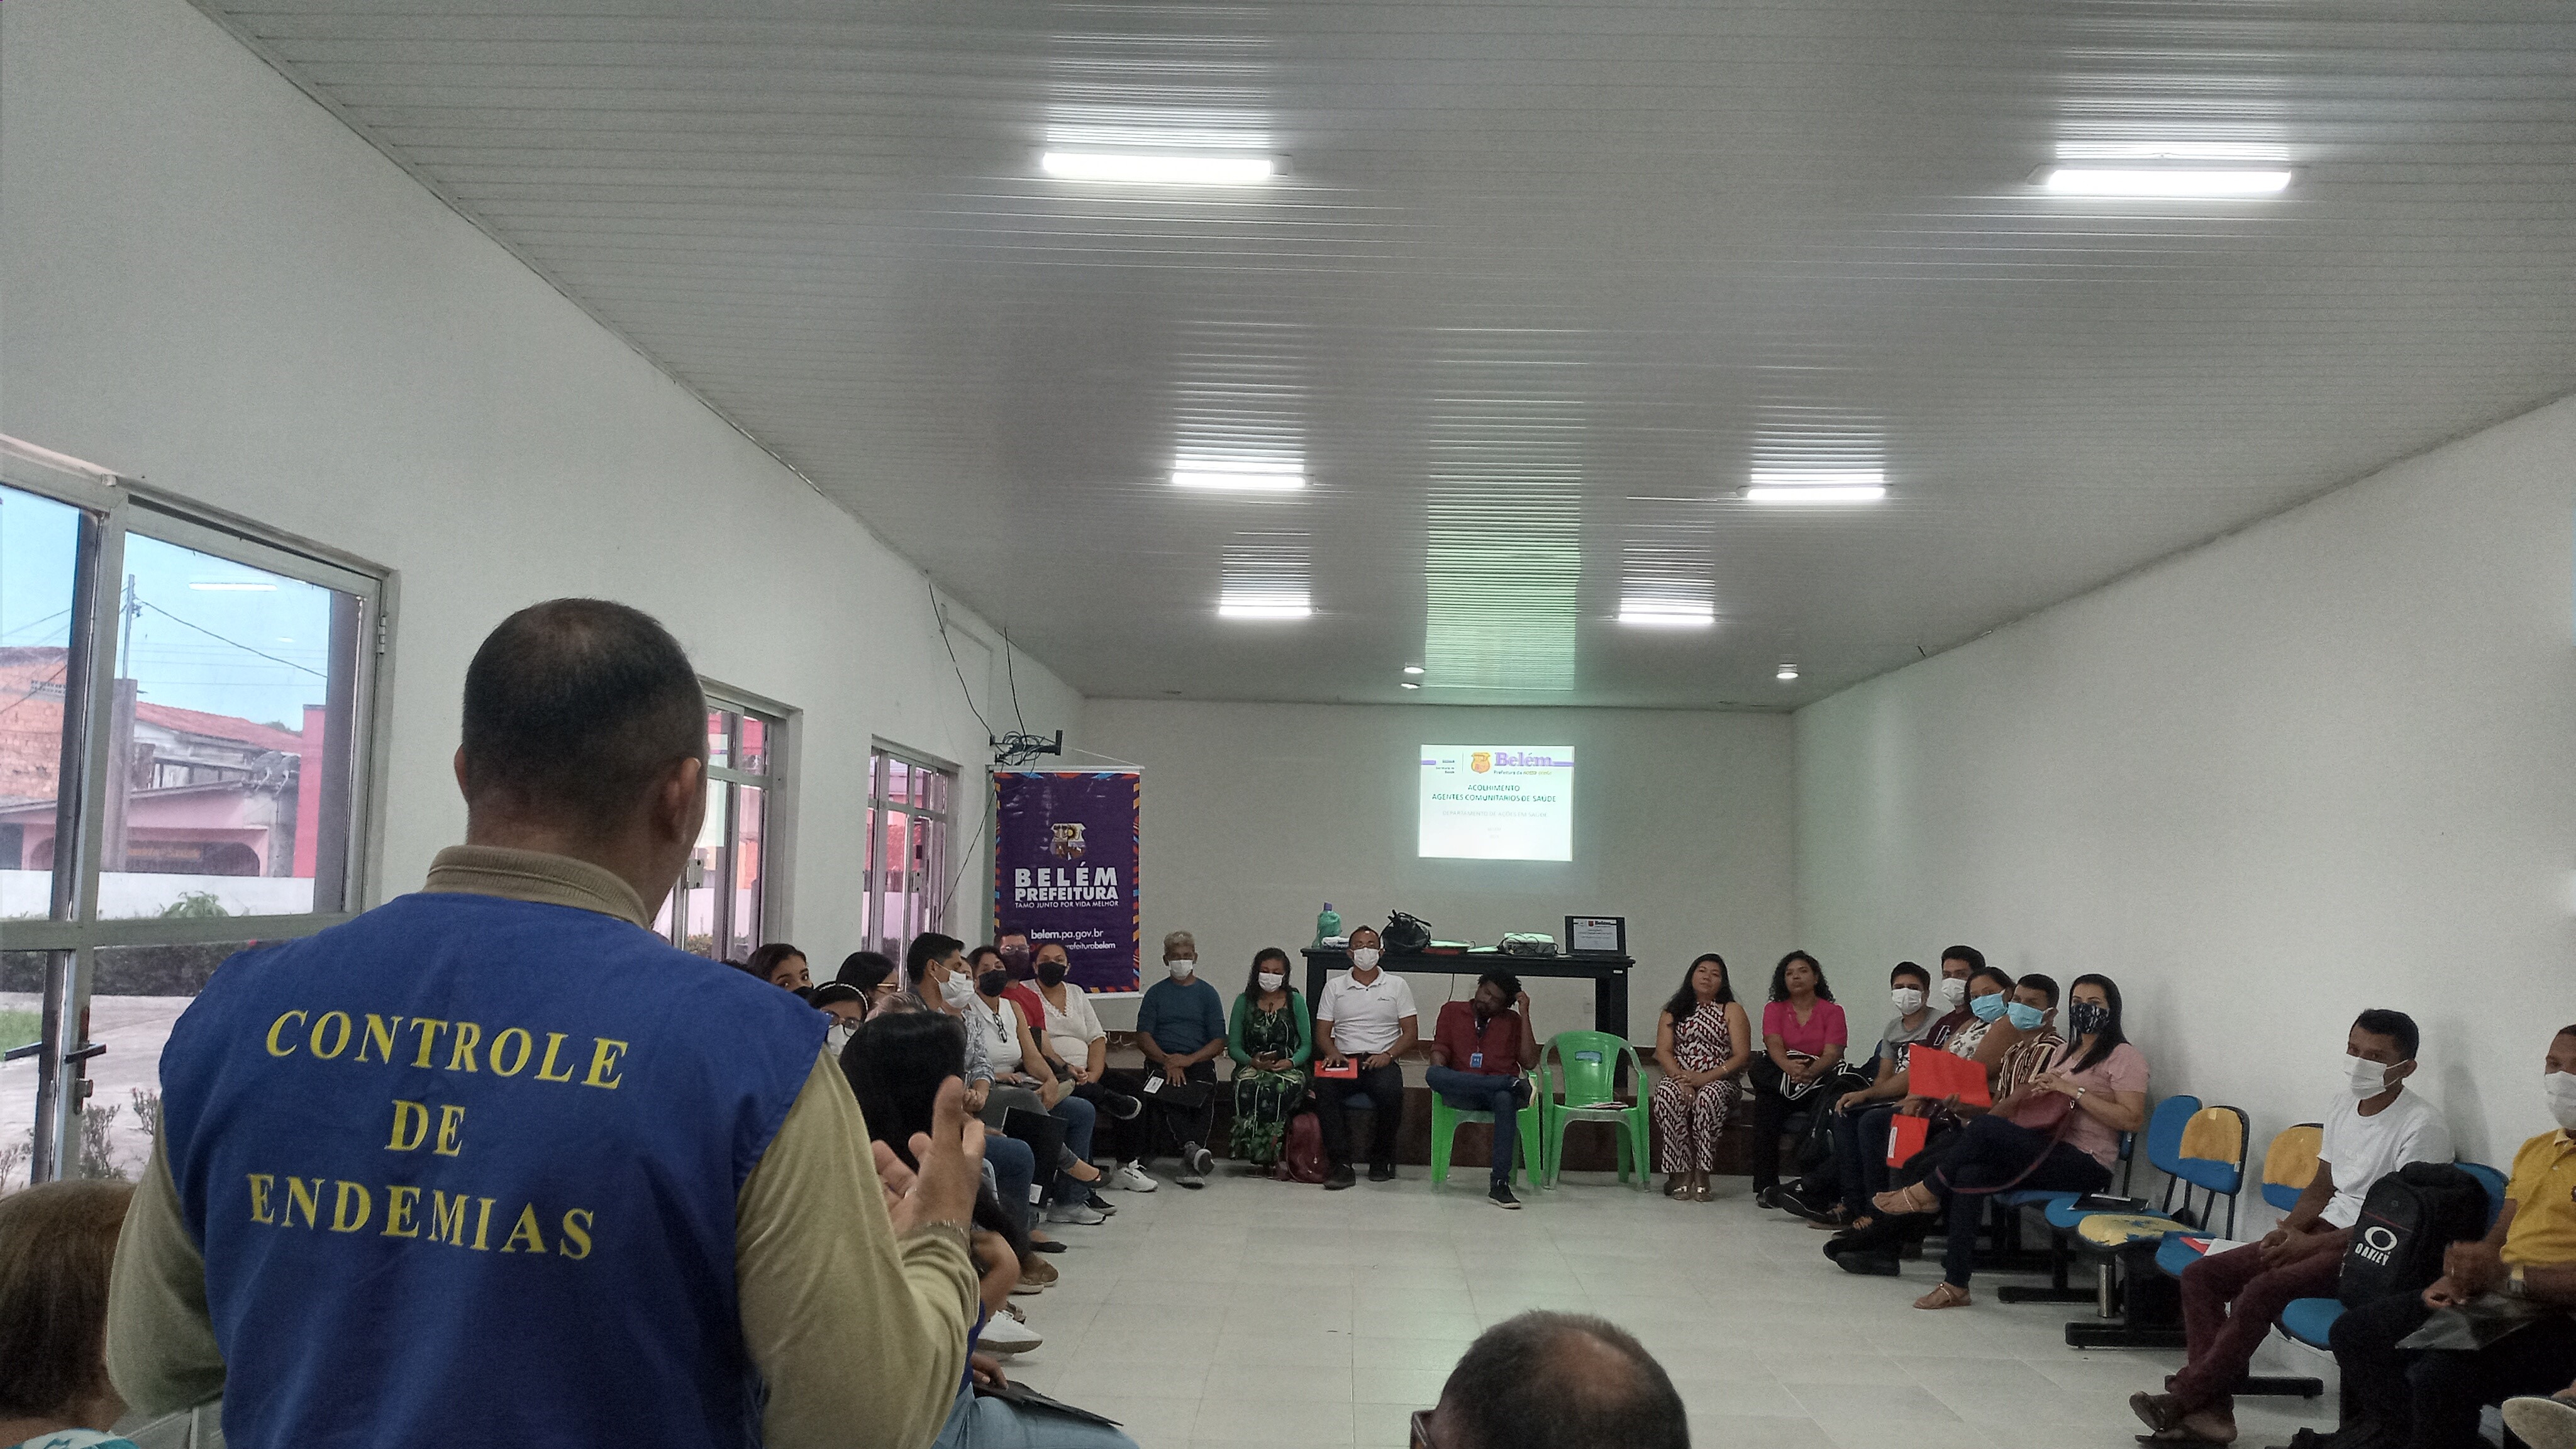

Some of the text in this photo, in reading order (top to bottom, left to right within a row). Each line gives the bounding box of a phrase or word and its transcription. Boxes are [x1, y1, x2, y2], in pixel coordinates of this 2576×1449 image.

[1494, 752, 1552, 767] Belém
[1015, 862, 1118, 887] BELÉM
[1015, 887, 1118, 901] PREFEITURA
[1031, 928, 1104, 940] belem.pa.gov.br
[265, 1009, 628, 1090] CONTROLE
[384, 1099, 466, 1157] DE
[247, 1173, 594, 1260] ENDEMIAS
